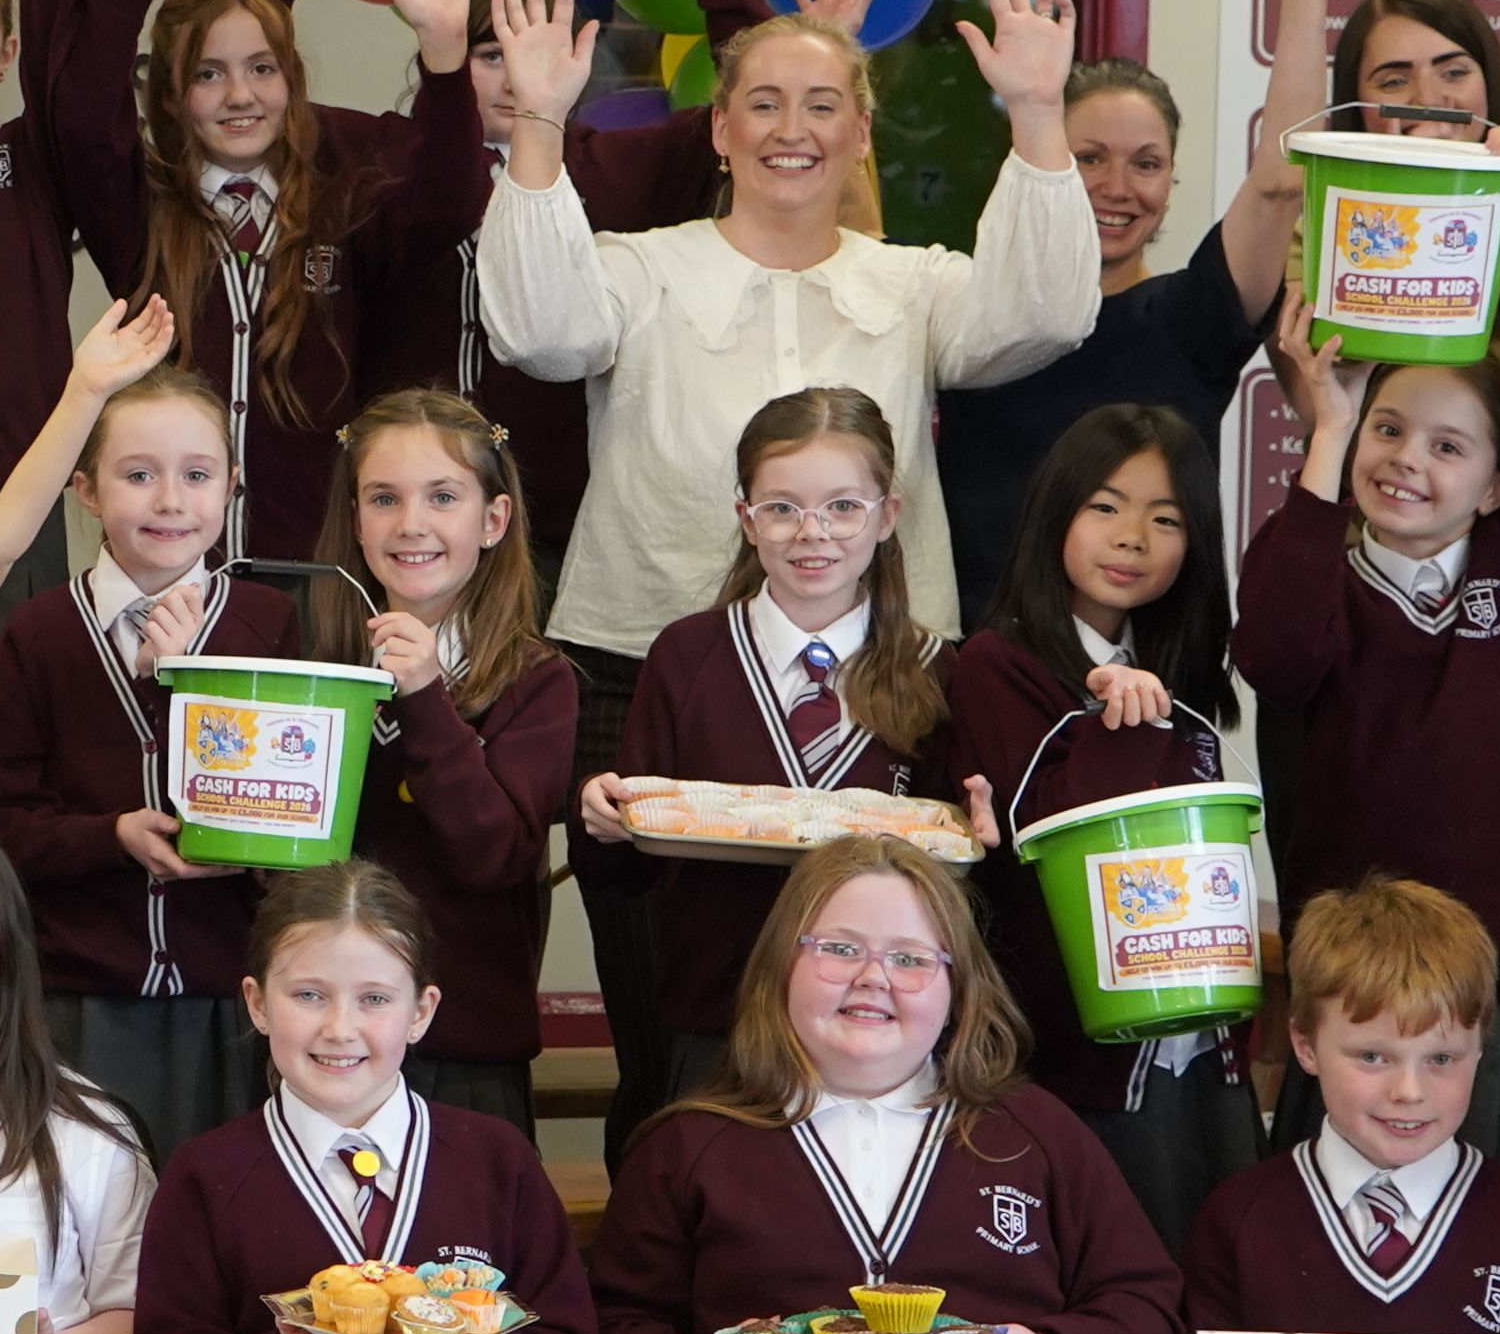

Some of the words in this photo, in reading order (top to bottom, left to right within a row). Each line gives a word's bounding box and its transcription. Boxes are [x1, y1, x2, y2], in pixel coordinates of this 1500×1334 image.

[1343, 275, 1391, 295] CASH
[1396, 279, 1434, 297] FOR
[1437, 279, 1475, 297] KIDS
[1345, 292, 1385, 305] SCHOOL
[1386, 295, 1449, 307] CHALLENGE
[195, 776, 234, 794] CASH
[237, 780, 272, 798] FOR
[275, 783, 316, 802] KIDS
[195, 792, 228, 805] SCHOOL
[229, 796, 287, 810] CHALLENGE
[1123, 933, 1175, 955] CASH
[1177, 929, 1214, 948] FOR
[1215, 927, 1249, 946] KIDS
[1127, 952, 1171, 966] SCHOOL
[1171, 946, 1229, 960] CHALLENGE
[993, 1184, 1043, 1210] BERNARD'S
[975, 1226, 1016, 1254] PRIMARY
[437, 1245, 452, 1259] ST.
[1472, 1265, 1488, 1278] ST.
[1461, 1304, 1500, 1334] PRIMARY
